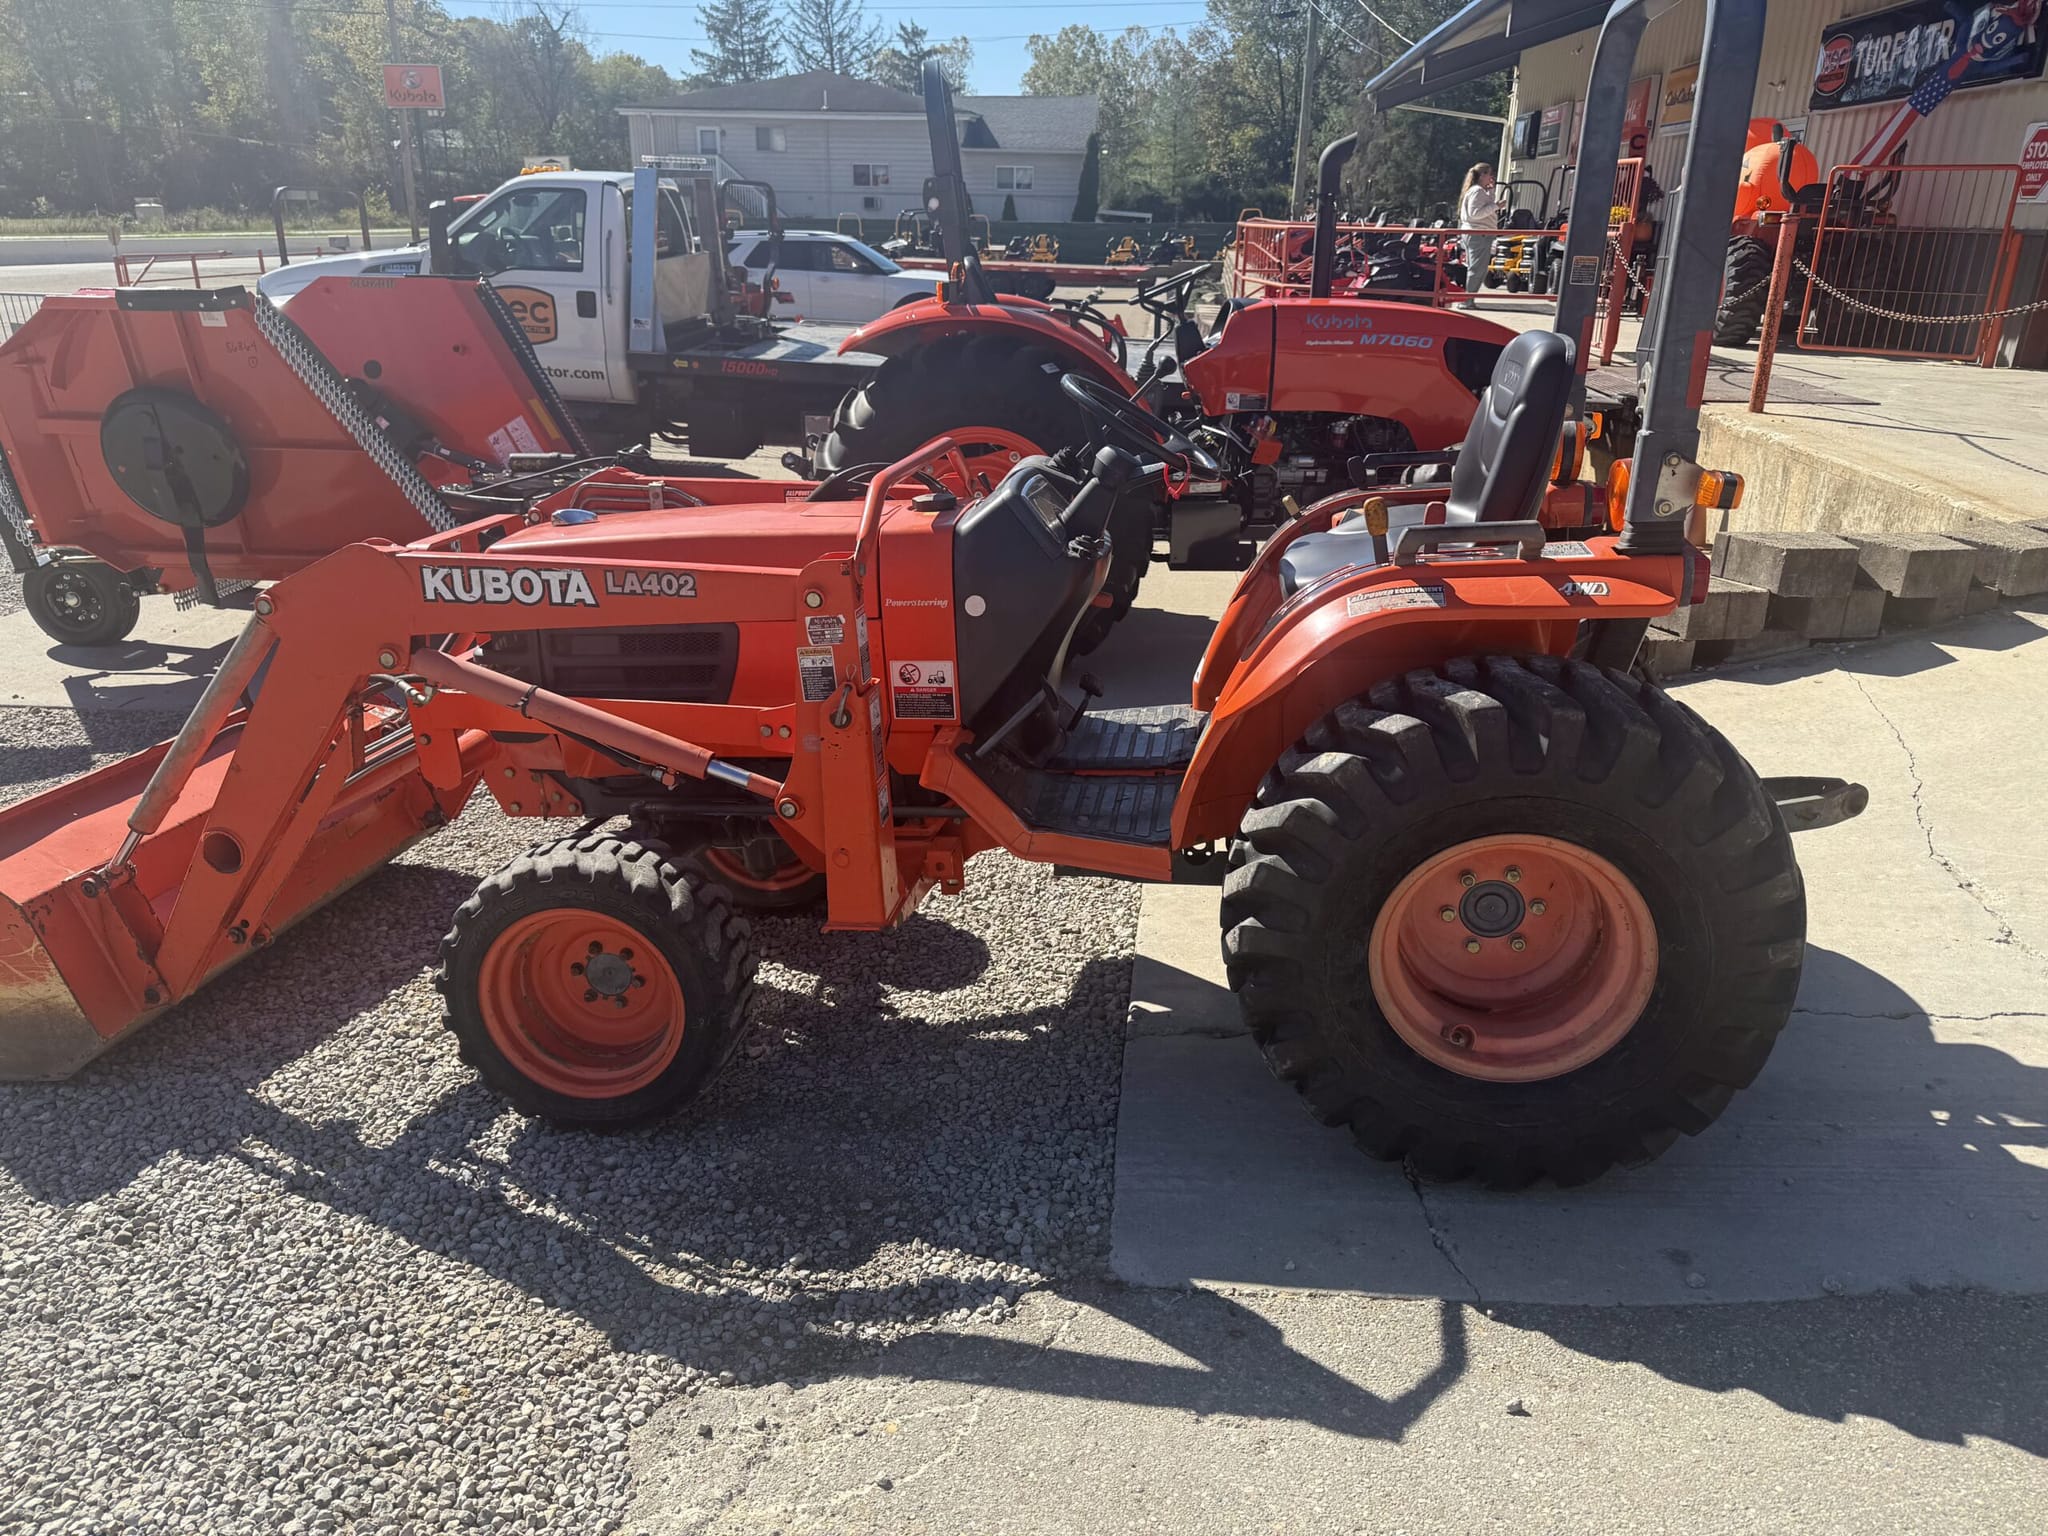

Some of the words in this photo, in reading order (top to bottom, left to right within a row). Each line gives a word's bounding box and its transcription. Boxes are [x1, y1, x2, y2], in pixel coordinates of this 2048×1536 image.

[1854, 30, 1905, 79] TURF
[389, 89, 437, 103] Kubota
[2026, 141, 2048, 159] STO
[2022, 161, 2048, 170] EMPLOYE
[2026, 173, 2042, 182] ONLY
[509, 300, 549, 324] ec
[1306, 313, 1373, 329] Kubota
[1360, 334, 1433, 349] M7060
[544, 366, 605, 380] tor.com
[421, 566, 598, 607] KUBOTA
[605, 571, 696, 597] LA402
[1394, 585, 1443, 595] EQUIPMENT
[1559, 582, 1610, 596] 4WD
